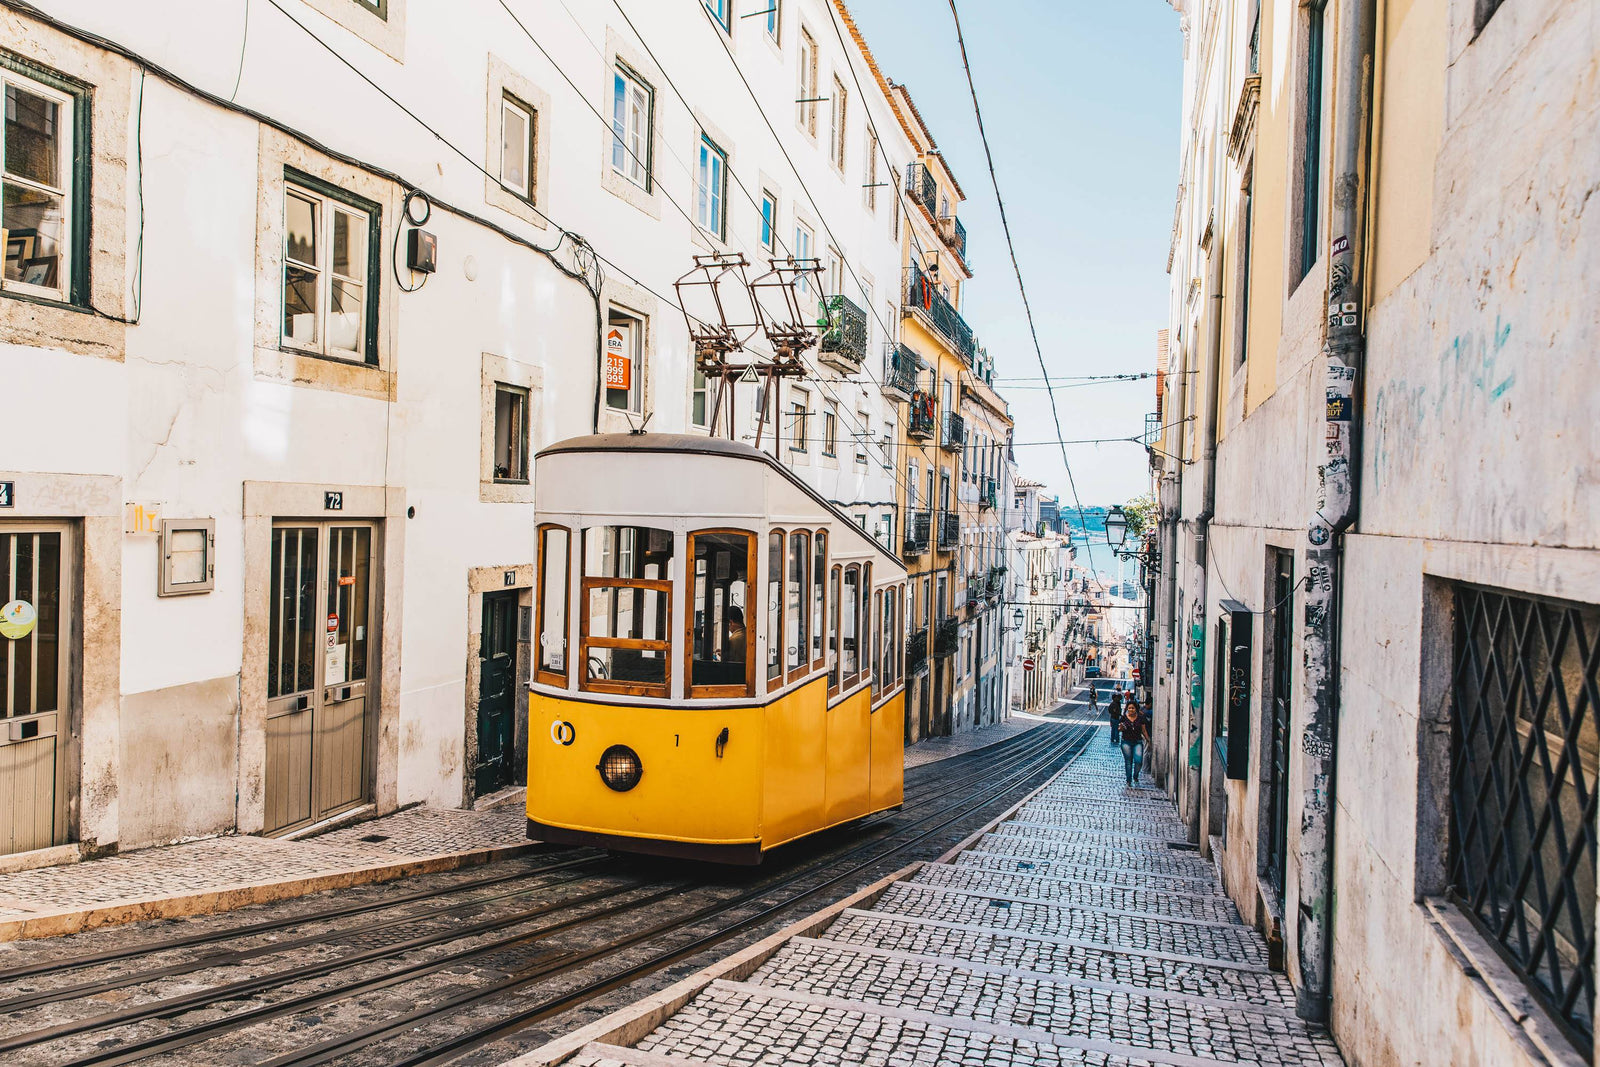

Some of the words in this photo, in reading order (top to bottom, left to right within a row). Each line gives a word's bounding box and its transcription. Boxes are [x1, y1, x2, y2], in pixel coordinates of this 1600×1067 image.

[608, 339, 622, 347] ERA
[607, 358, 624, 367] 215
[607, 366, 624, 375] 999
[607, 374, 624, 384] 995
[328, 493, 341, 509] 72
[506, 572, 515, 585] 70
